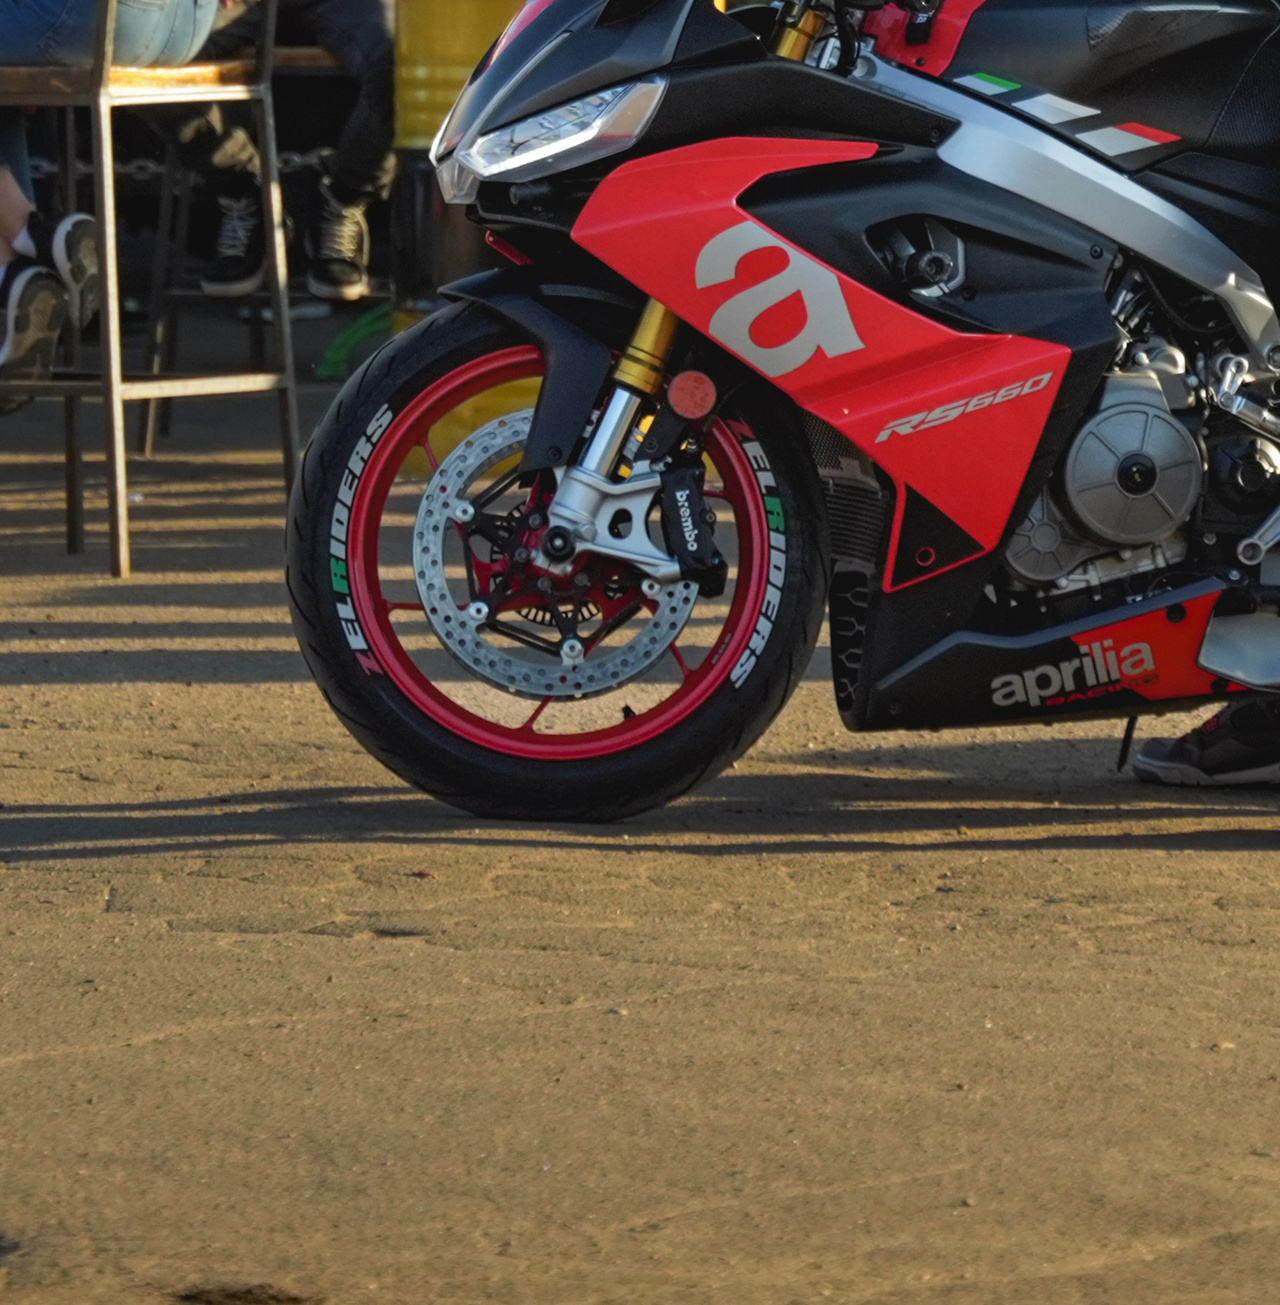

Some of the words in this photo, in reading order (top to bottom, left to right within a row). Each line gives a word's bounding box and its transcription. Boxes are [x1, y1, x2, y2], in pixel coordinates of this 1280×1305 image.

[874, 371, 1054, 445] RS660
[675, 489, 699, 552] brembo
[990, 638, 1156, 708] aprilia
